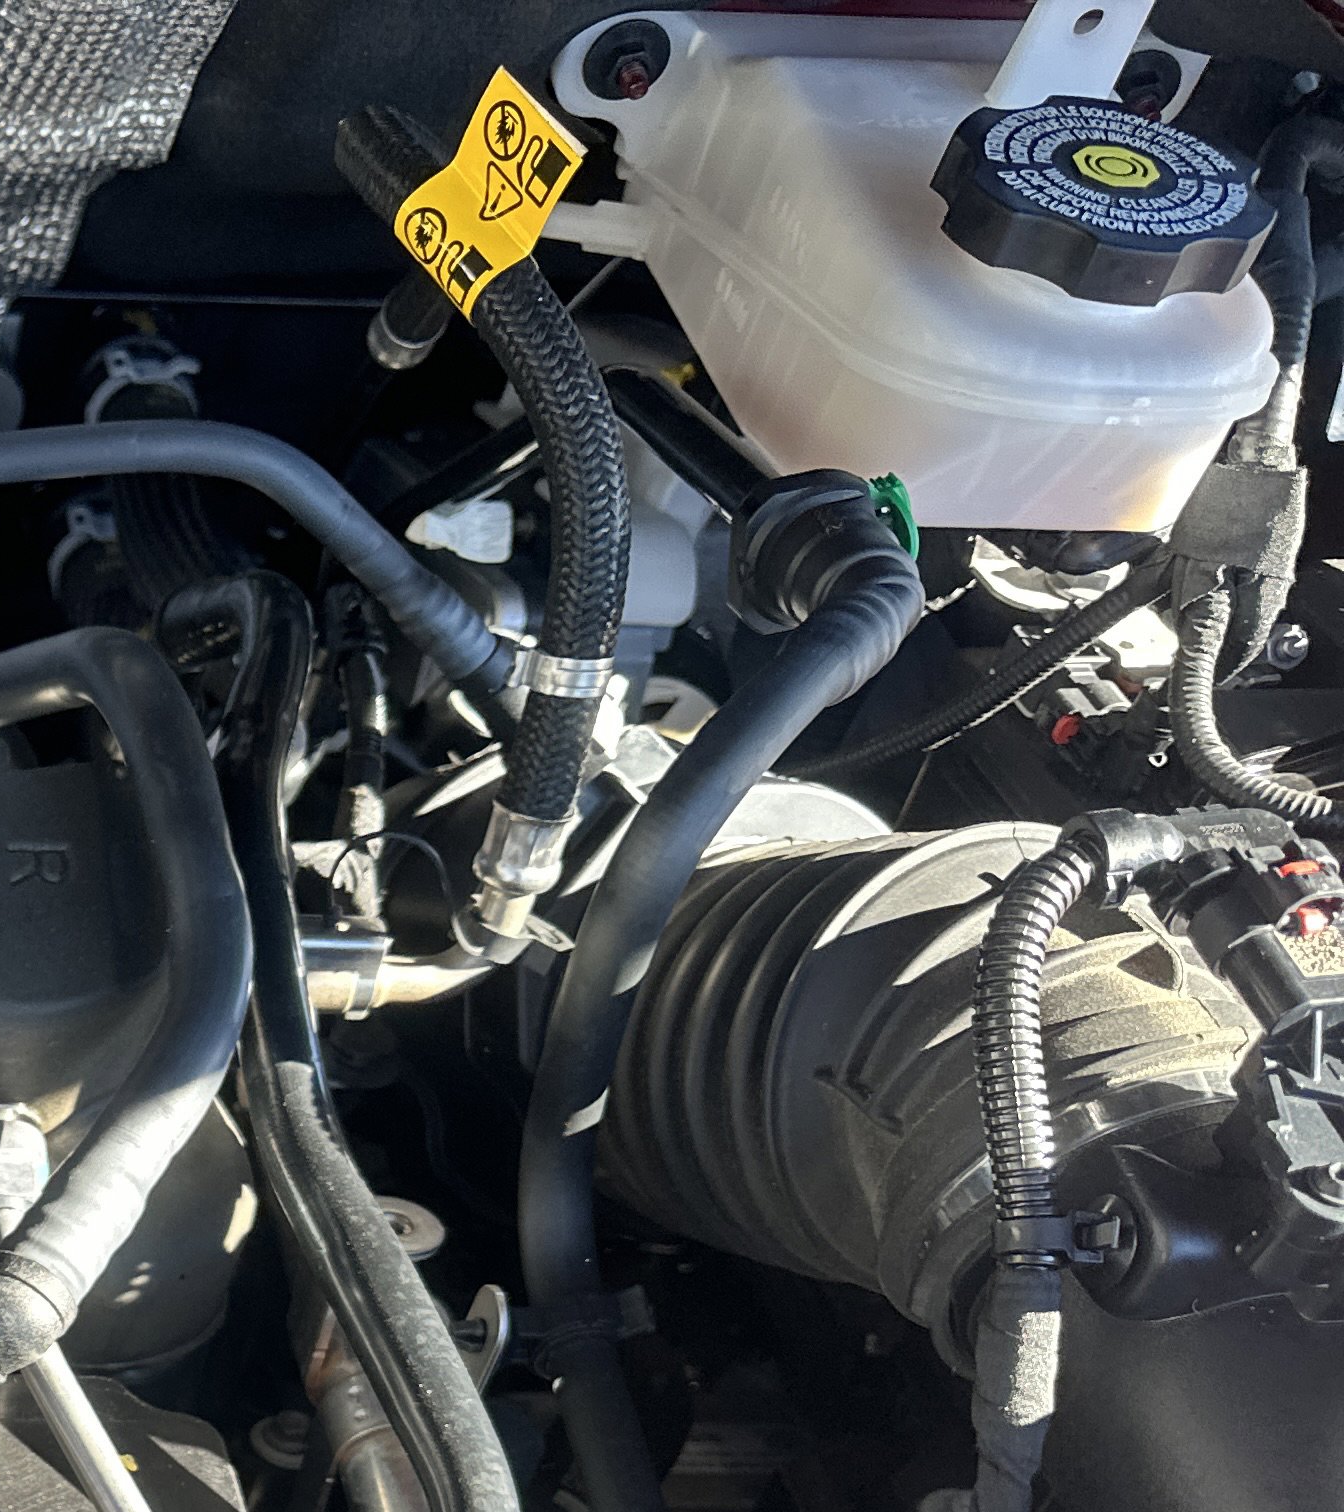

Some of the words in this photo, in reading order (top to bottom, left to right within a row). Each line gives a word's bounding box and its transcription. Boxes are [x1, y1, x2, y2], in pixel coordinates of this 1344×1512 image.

[1060, 106, 1079, 117] LE
[1079, 107, 1149, 126] BOUCHON
[1148, 121, 1196, 142] AVANT
[1063, 117, 1081, 128] DU
[1081, 118, 1135, 133] LIQUIDE
[1135, 127, 1157, 139] DE
[1107, 132, 1151, 149] BIDON
[1020, 169, 1051, 190] CAP
[1044, 184, 1108, 215] BEFORE
[1119, 195, 1173, 209] CLEAN
[1030, 193, 1079, 217] FLUID
[1082, 212, 1134, 233] FROM
[1136, 222, 1150, 235] A
[1149, 217, 1211, 235] SEALED
[7, 842, 69, 887] R
